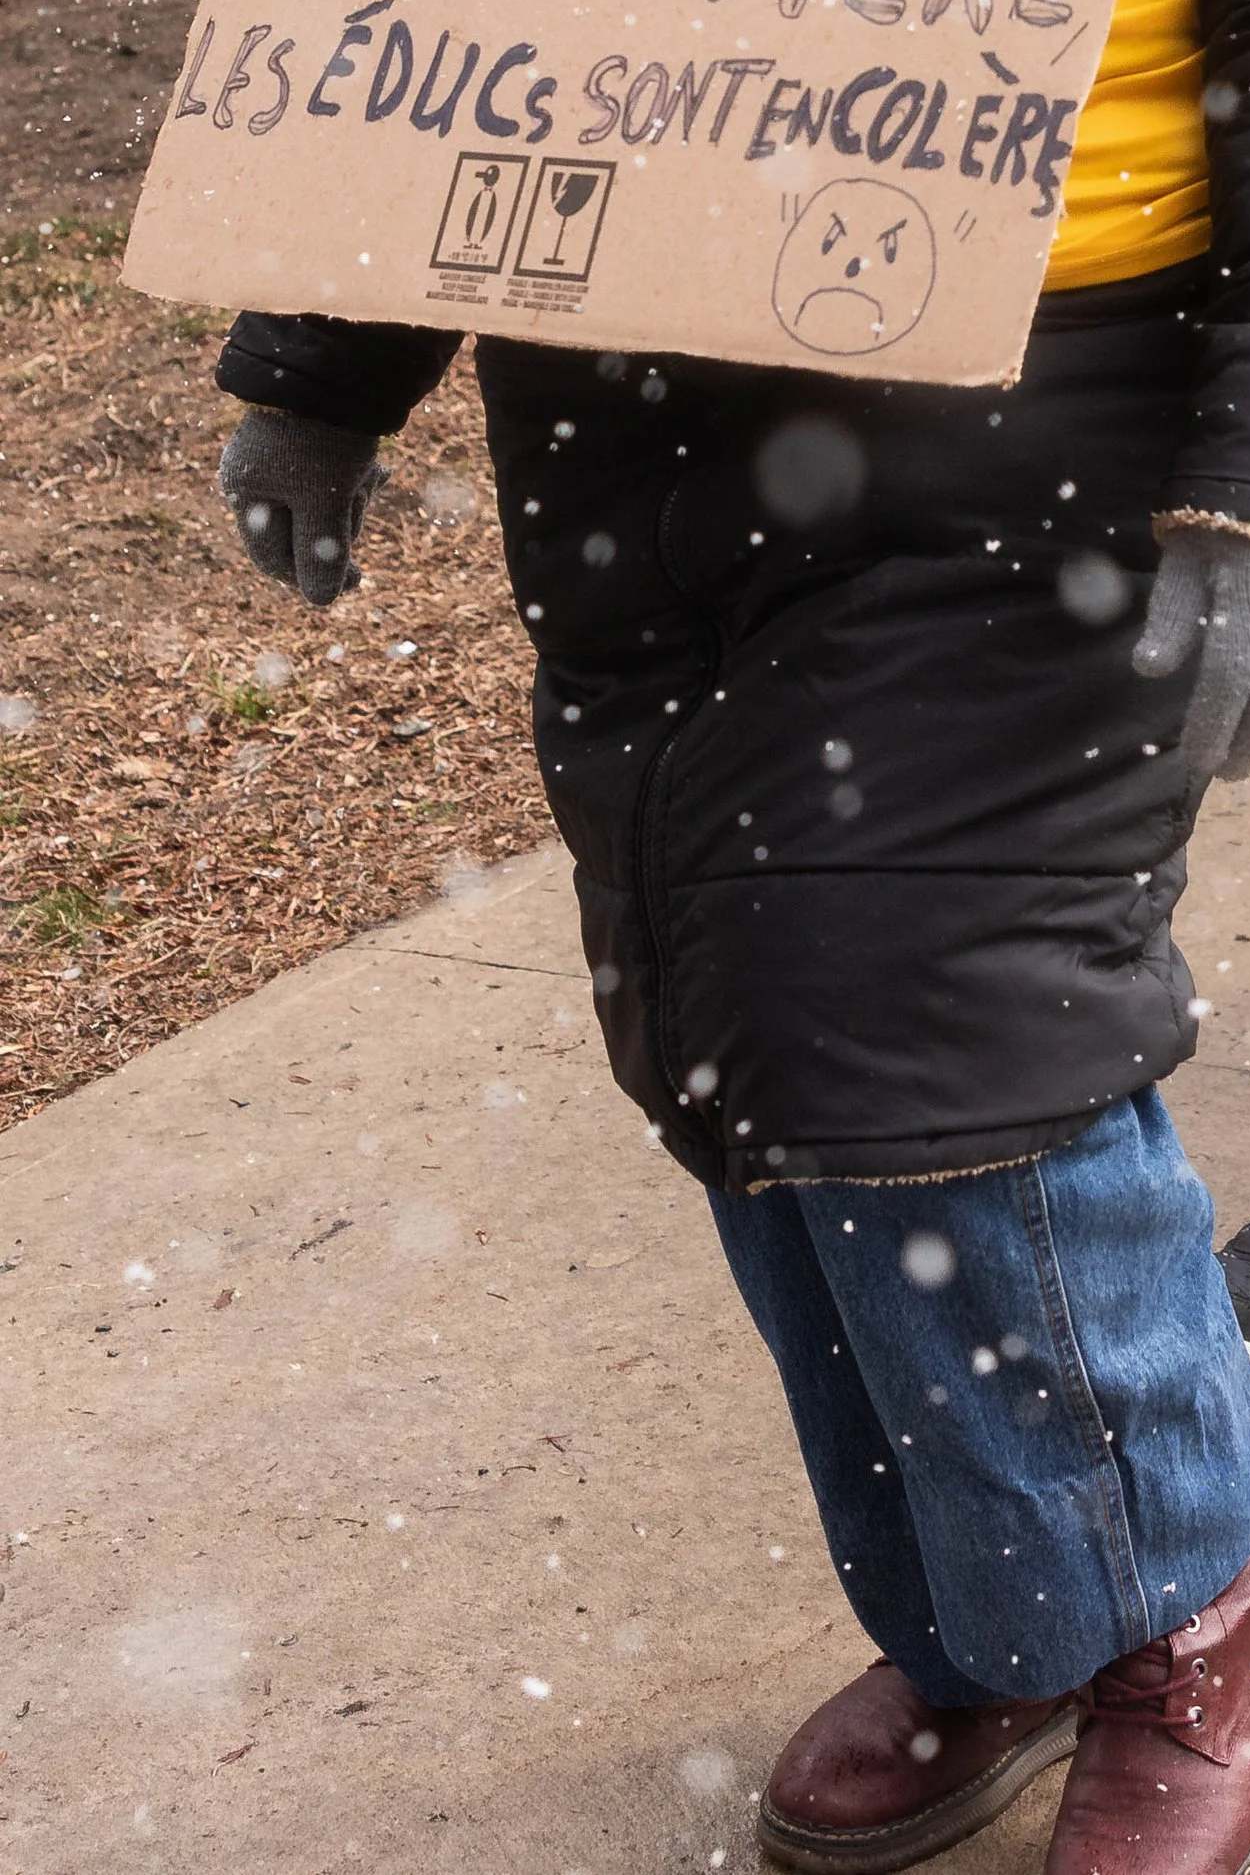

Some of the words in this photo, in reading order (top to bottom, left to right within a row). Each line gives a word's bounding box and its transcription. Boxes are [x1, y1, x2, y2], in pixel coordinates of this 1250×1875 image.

[175, 15, 296, 136] LES
[577, 54, 776, 147] SONT
[745, 77, 832, 161] EN
